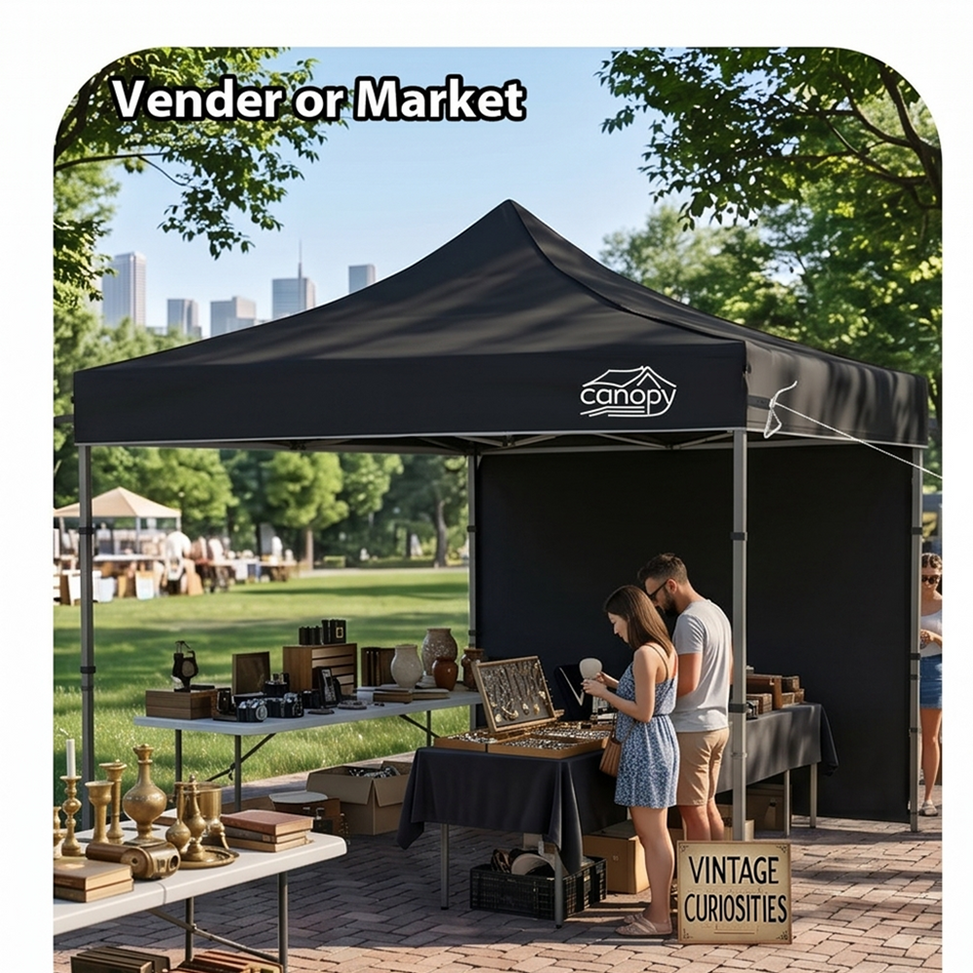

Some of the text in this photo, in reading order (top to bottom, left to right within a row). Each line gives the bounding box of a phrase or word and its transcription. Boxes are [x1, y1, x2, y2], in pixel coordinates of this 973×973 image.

[579, 387, 677, 417] canopy
[688, 855, 780, 885] VINTAGE
[684, 893, 788, 924] CURIOSITIES
